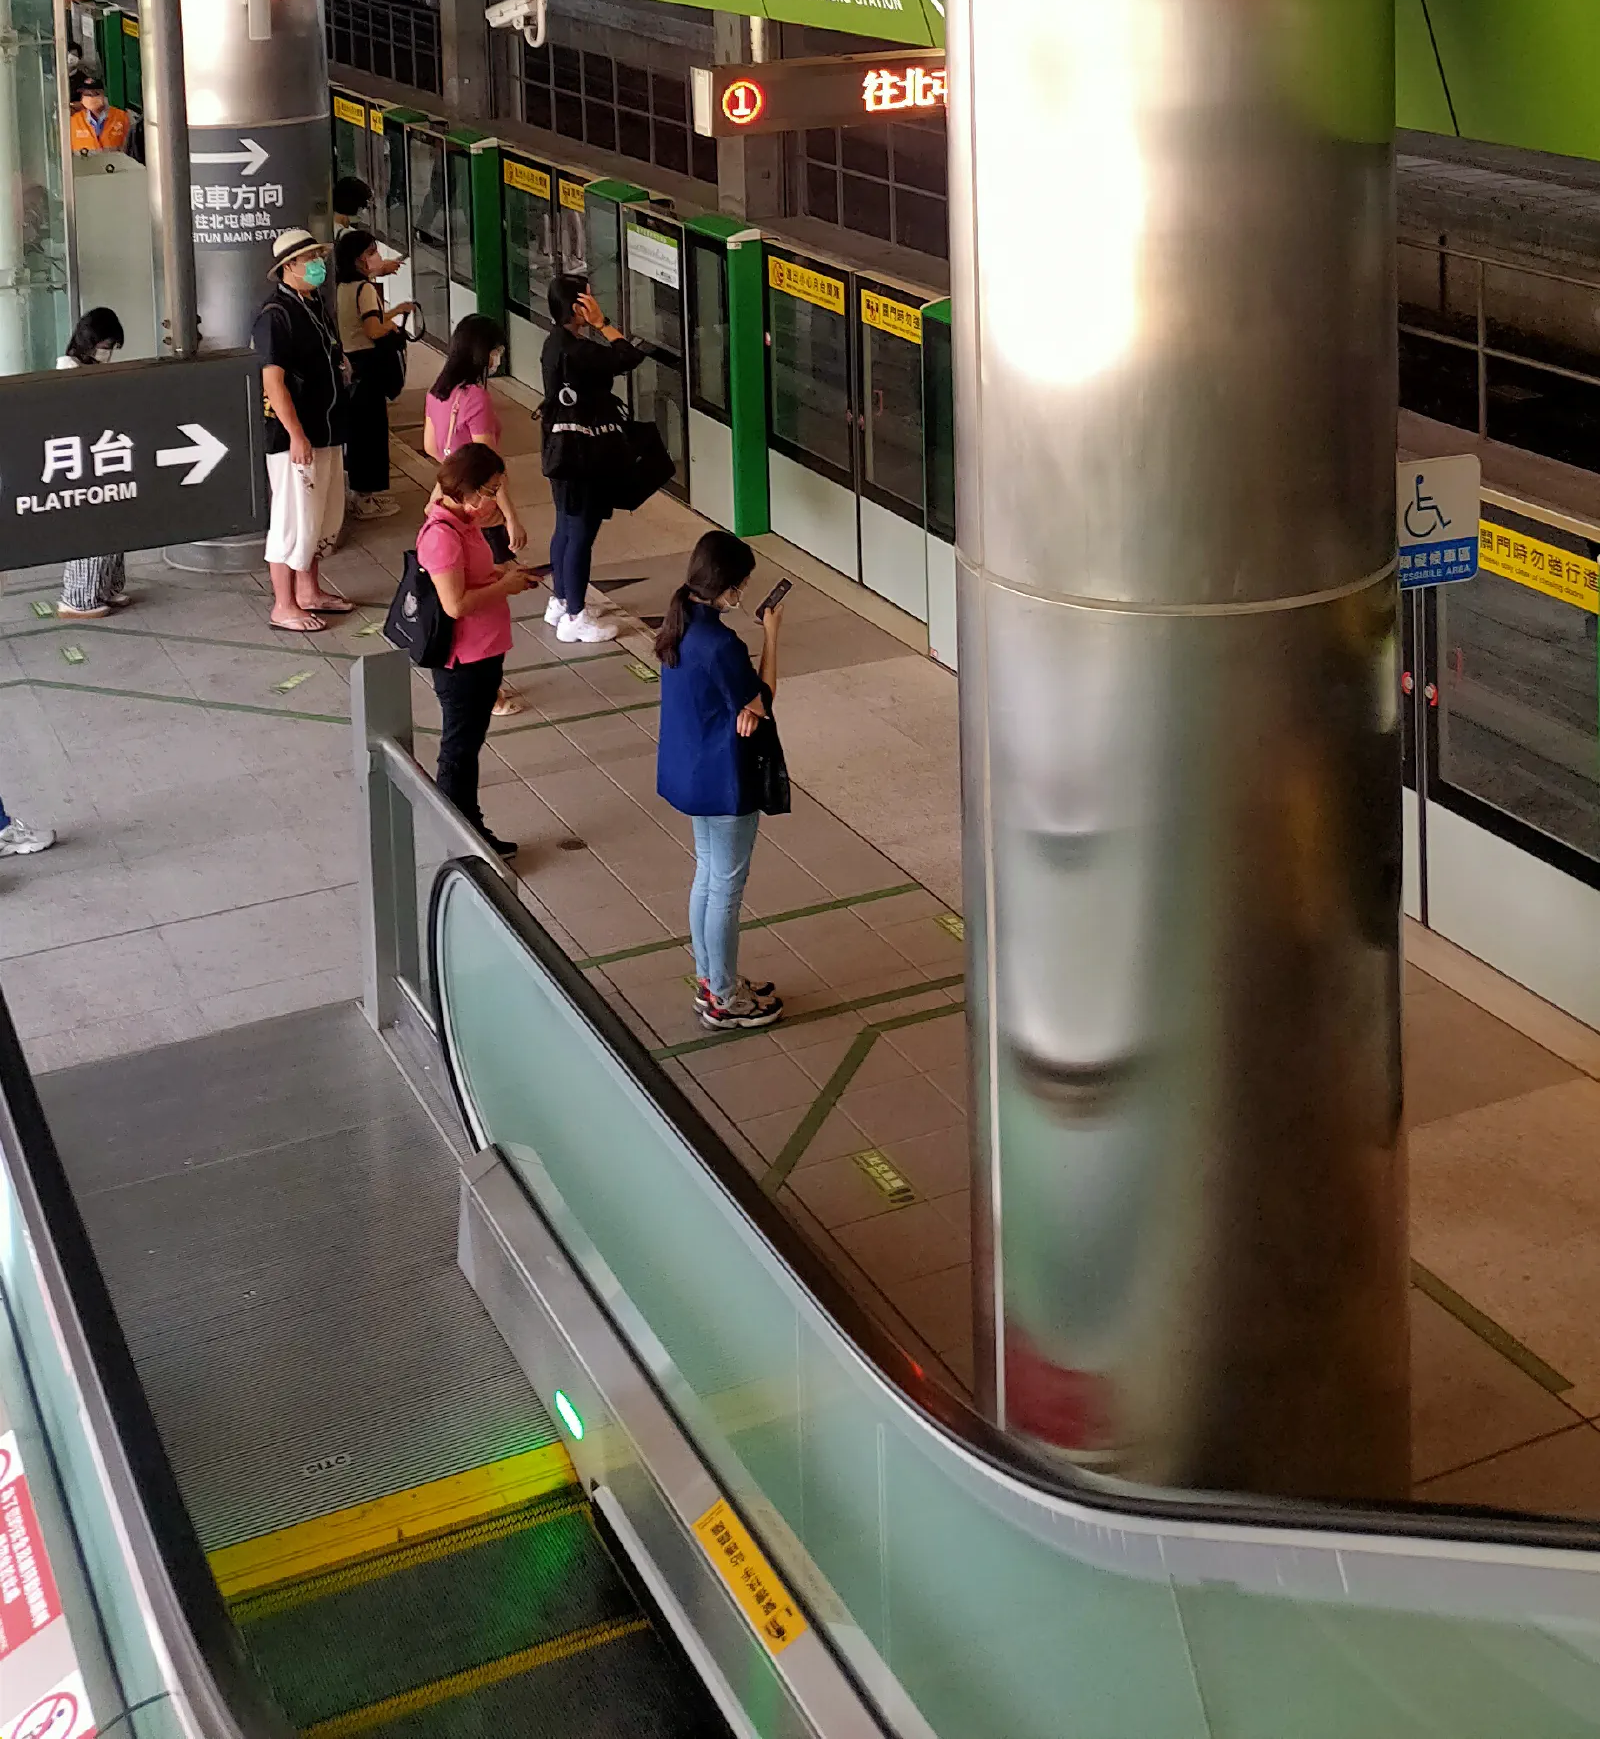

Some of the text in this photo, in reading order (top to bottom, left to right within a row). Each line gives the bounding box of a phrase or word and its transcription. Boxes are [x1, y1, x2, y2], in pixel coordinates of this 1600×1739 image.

[195, 211, 271, 230] 往北屯總站
[223, 231, 253, 243] MAIN
[41, 429, 135, 484] 月台
[16, 481, 138, 515] PLATFORM
[1479, 552, 1500, 567] Please
[1446, 563, 1471, 575] AREA
